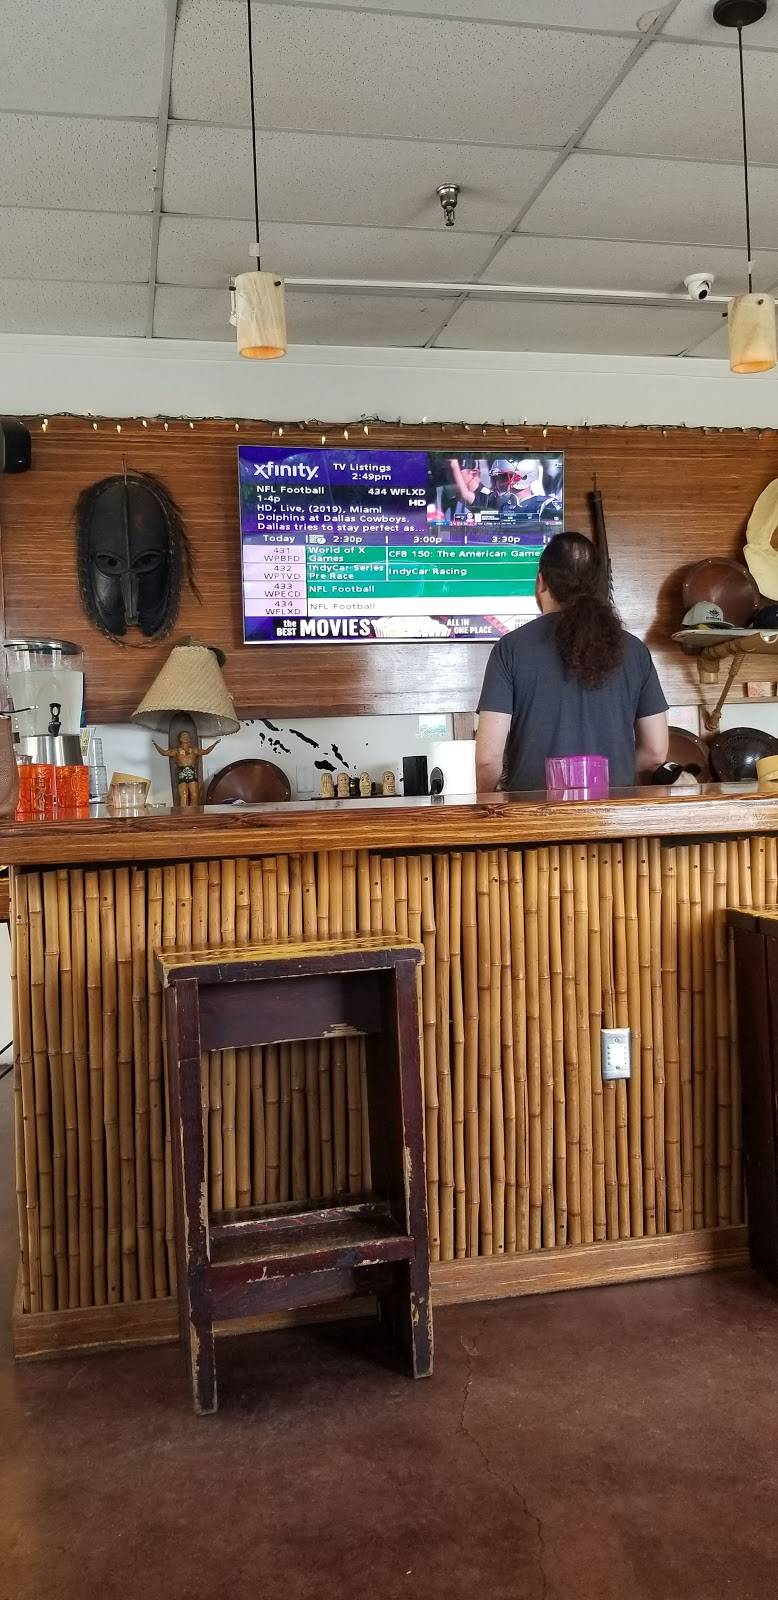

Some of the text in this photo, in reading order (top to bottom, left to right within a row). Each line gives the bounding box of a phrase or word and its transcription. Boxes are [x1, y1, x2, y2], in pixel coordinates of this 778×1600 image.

[333, 463, 391, 473] TV Listings
[352, 473, 391, 481] 2:49pm
[256, 485, 325, 494] NFL Football
[390, 488, 426, 496] WFLXD
[257, 495, 281, 504] 1-4p
[408, 499, 427, 507] HD
[257, 504, 382, 514] HD, Live, (2019), Miami
[257, 513, 410, 524] Dolphins at Dallas Cowboys.
[257, 522, 291, 531] Dallas
[294, 523, 319, 531] tries
[337, 524, 359, 532] stay
[363, 524, 400, 533] perfect
[263, 534, 295, 543] Today
[333, 535, 362, 544] 2:30p
[413, 536, 442, 544] 3:00p
[491, 535, 520, 543] 3:30p
[308, 546, 340, 554] World
[388, 550, 408, 558] CFB
[309, 554, 344, 562] Games
[309, 564, 384, 572] IndyCar Series
[388, 567, 468, 576] IndyCar Racing
[309, 585, 375, 593] NFL Football
[333, 602, 376, 610] Football
[283, 619, 297, 628] the
[446, 618, 470, 627] ALL IN
[276, 627, 297, 637] BEST
[300, 618, 371, 637] MOVIES
[453, 626, 493, 634] ONE PLACE
